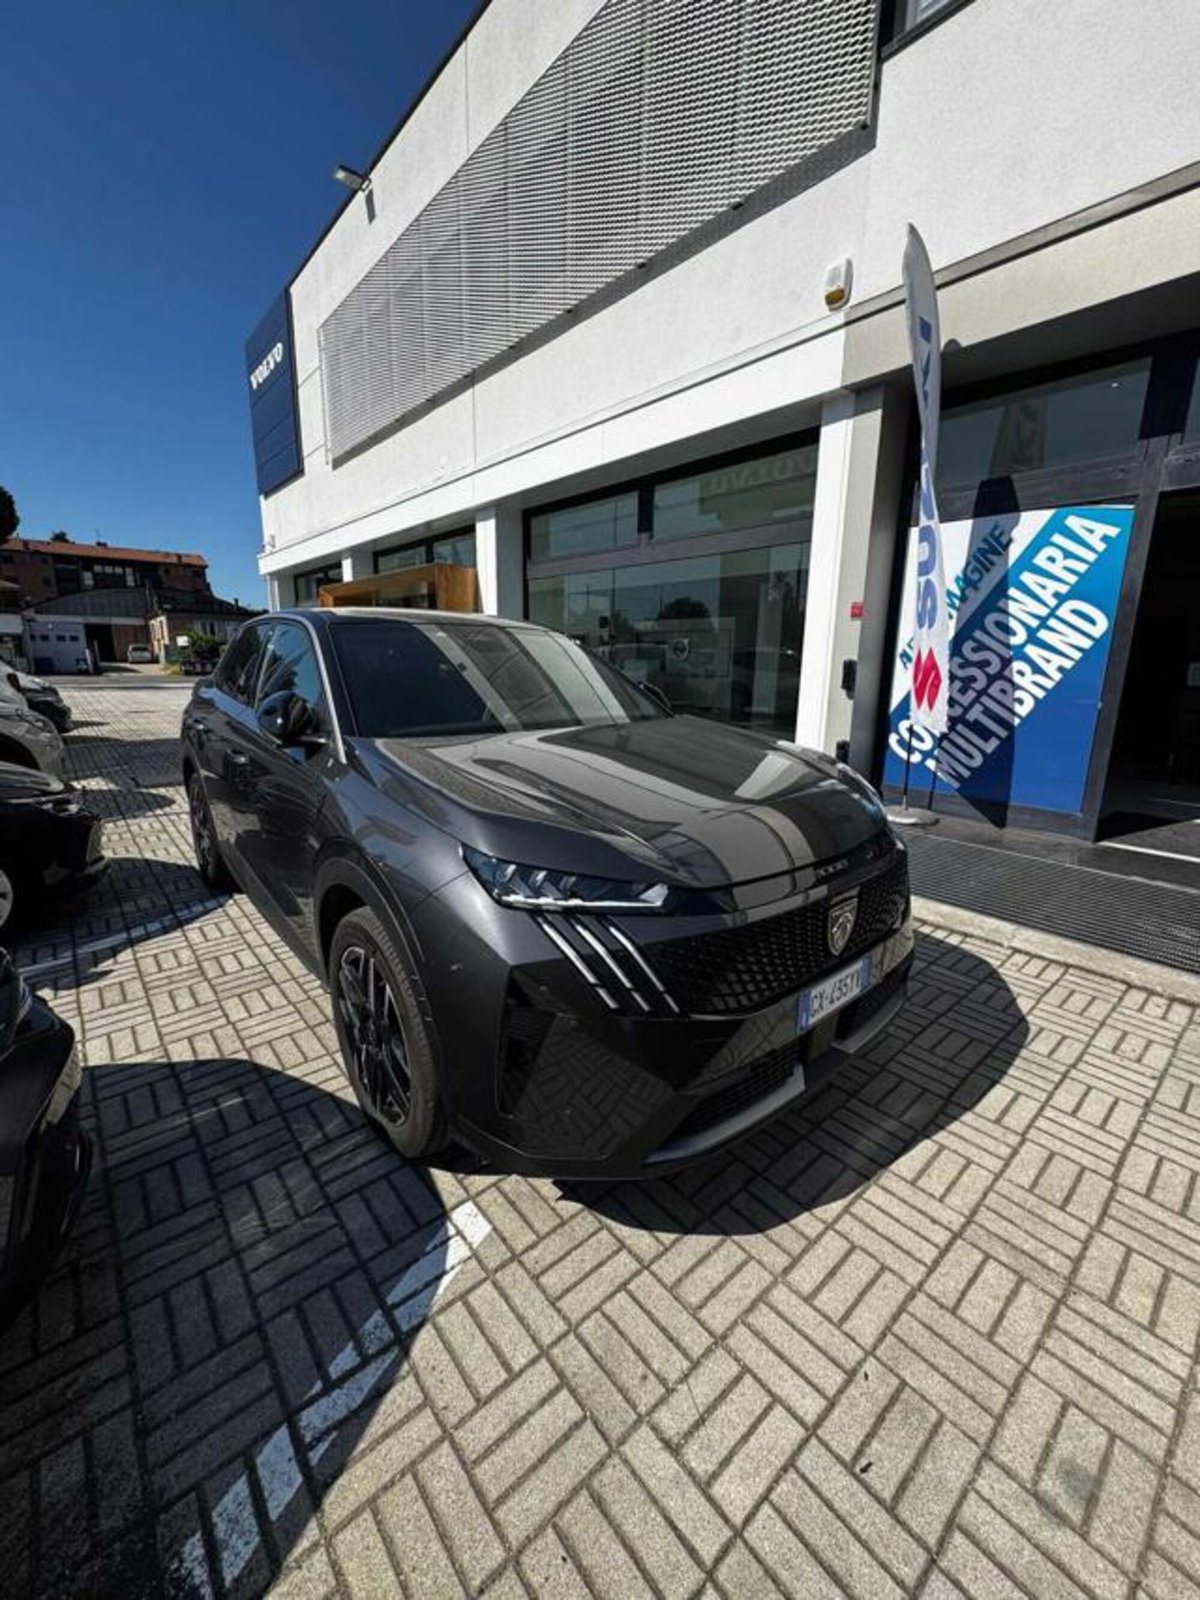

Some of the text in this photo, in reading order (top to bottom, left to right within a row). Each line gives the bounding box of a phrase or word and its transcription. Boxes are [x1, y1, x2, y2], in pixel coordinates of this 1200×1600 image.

[250, 342, 283, 389] VOLVO
[889, 514, 1122, 763] COESSIONARIA
[924, 600, 1110, 788] MULTIBRAND
